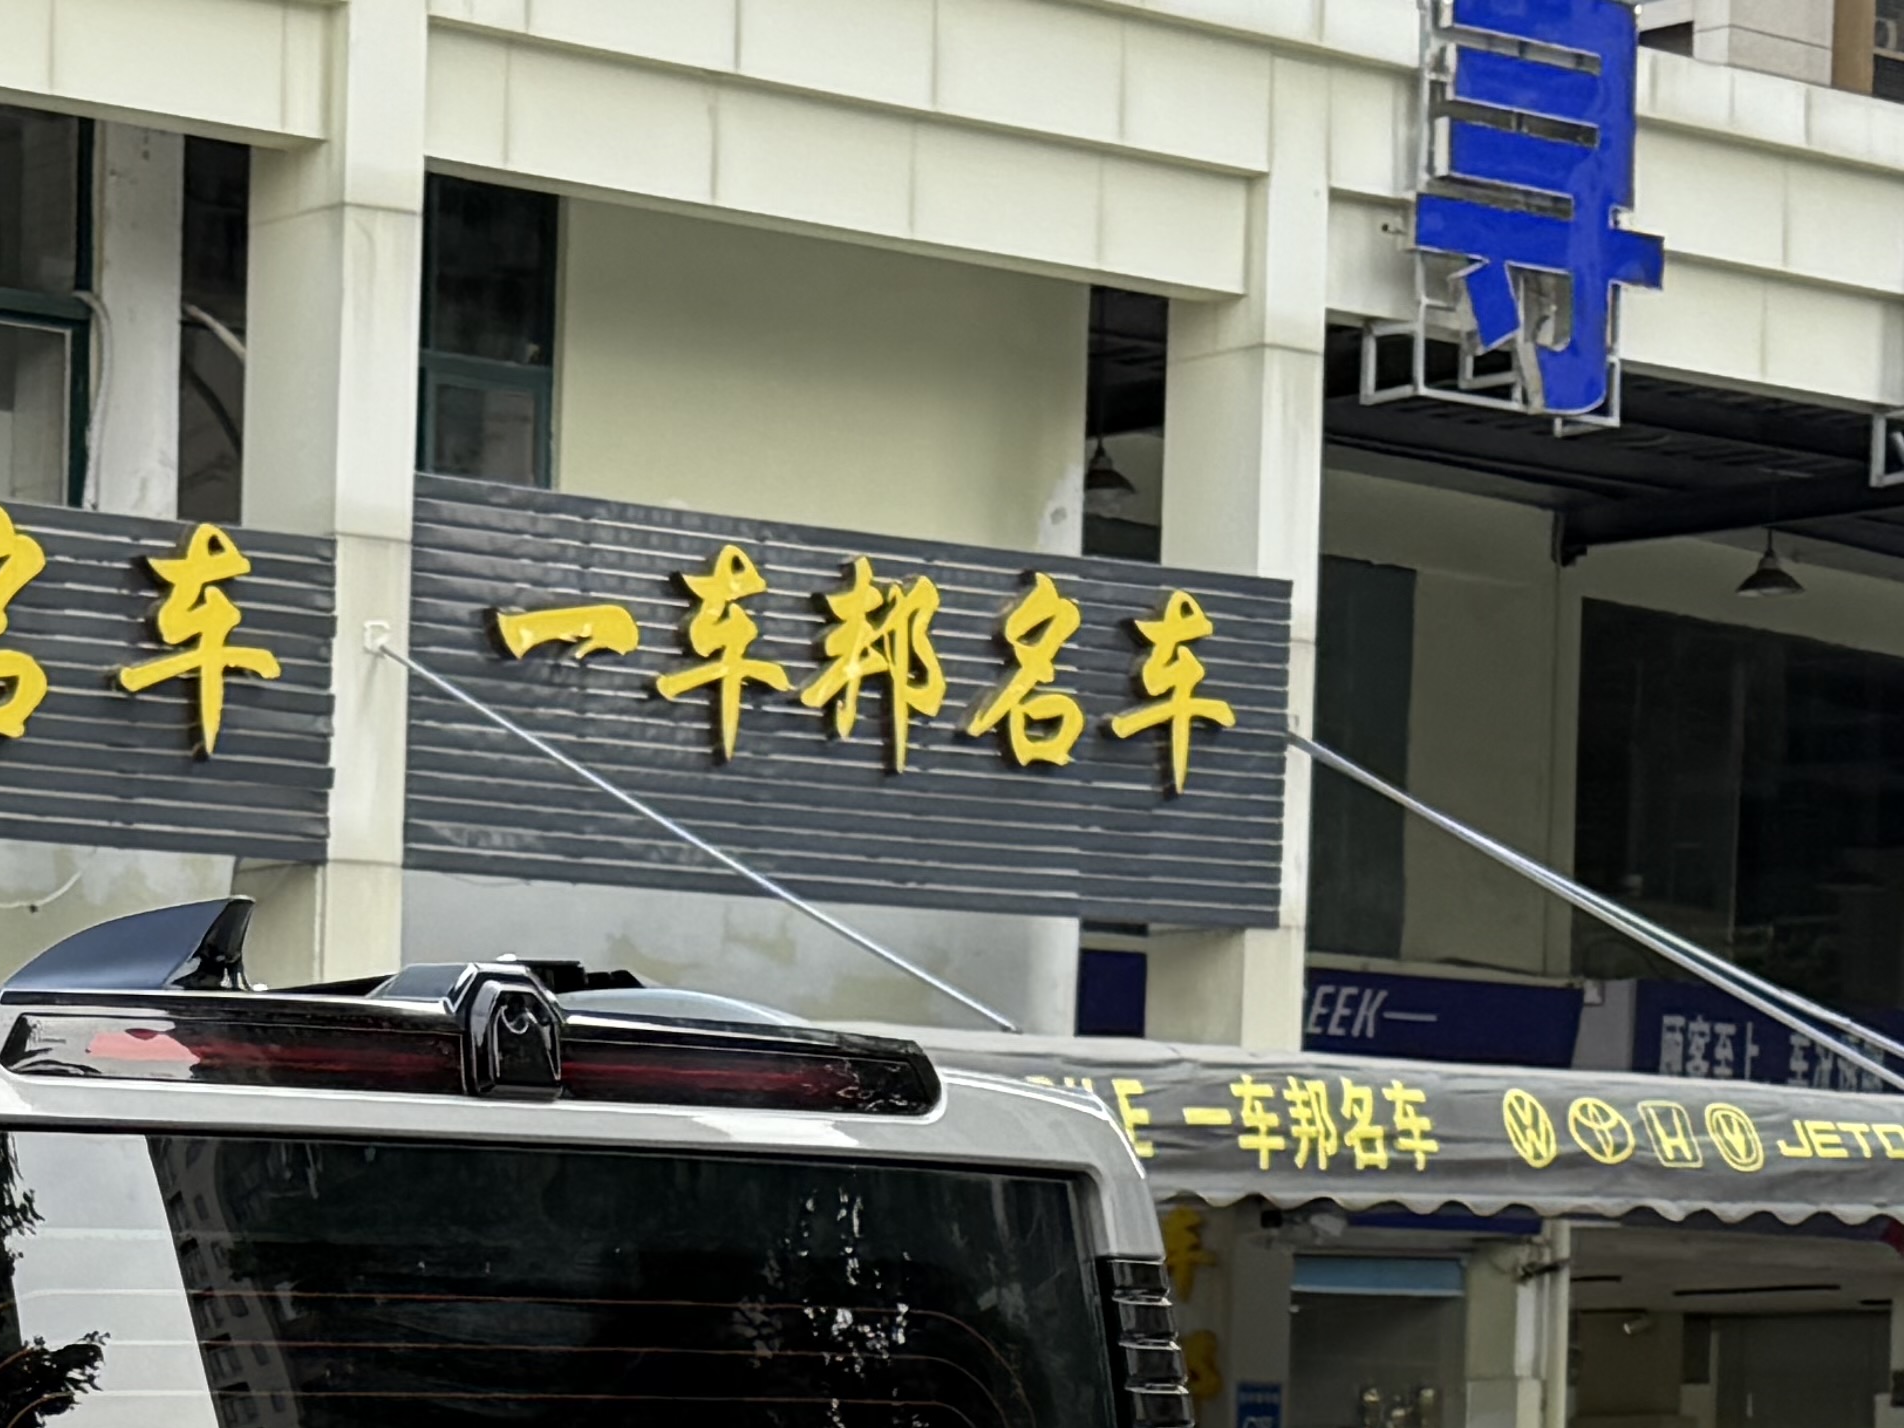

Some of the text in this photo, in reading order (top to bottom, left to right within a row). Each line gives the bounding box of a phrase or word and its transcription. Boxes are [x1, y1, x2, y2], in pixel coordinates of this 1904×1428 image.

[495, 542, 1236, 793] 一车邦名车
[1182, 1075, 1439, 1170] 一车邦名车
